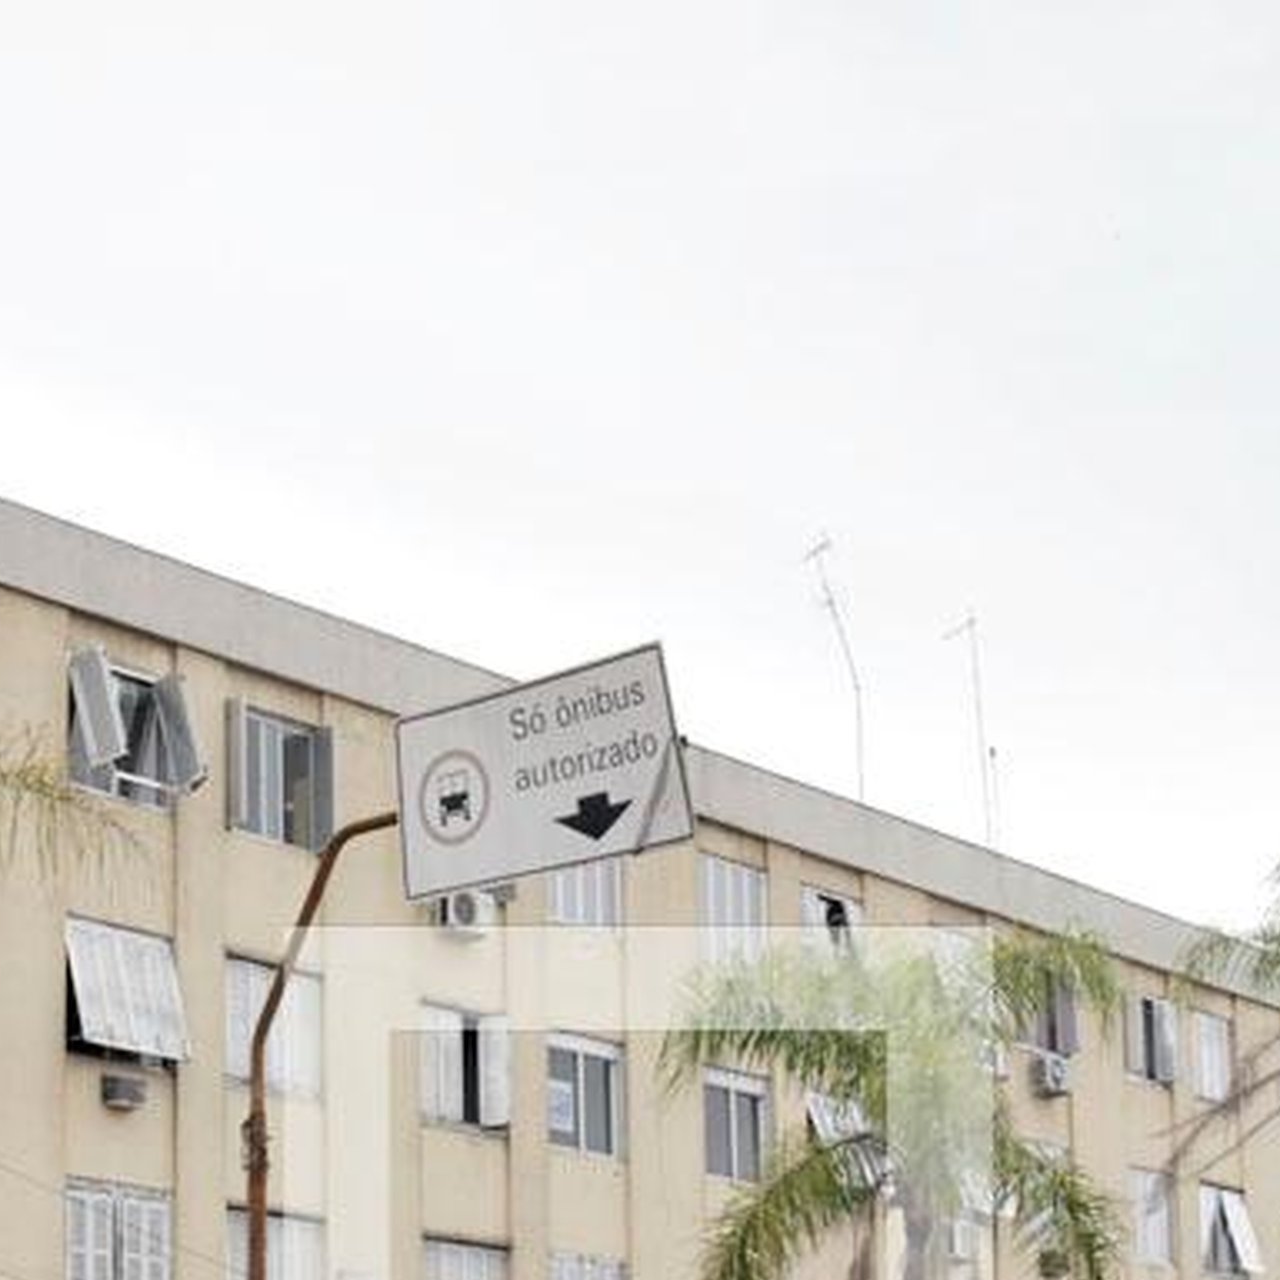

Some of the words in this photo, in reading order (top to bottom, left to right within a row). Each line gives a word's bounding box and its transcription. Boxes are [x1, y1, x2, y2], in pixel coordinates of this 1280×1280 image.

[509, 702, 547, 741] Só
[556, 681, 645, 728] ônibus
[515, 730, 658, 791] autorizado
